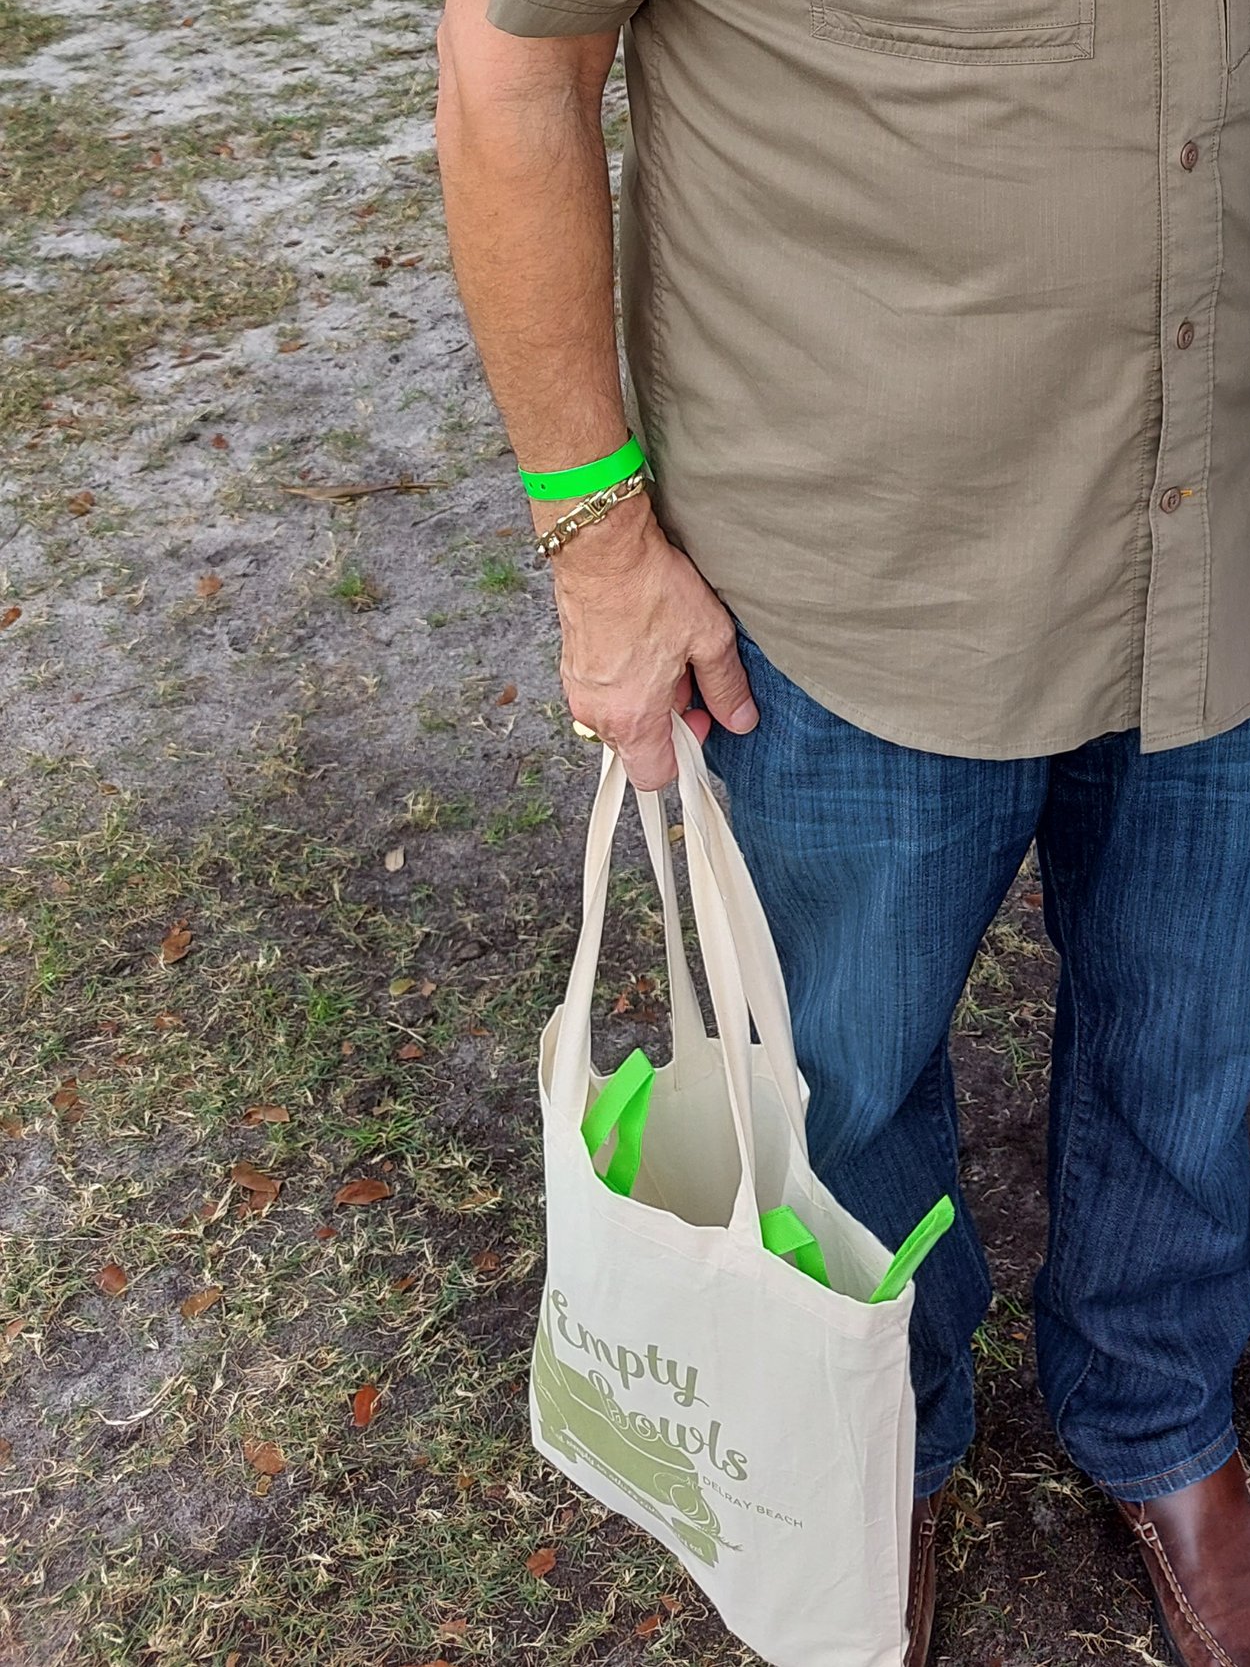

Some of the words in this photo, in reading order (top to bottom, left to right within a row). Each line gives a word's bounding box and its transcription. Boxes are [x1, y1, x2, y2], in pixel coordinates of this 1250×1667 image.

[550, 1289, 709, 1407] Empty
[587, 1369, 748, 1481] Bowls
[702, 1475, 752, 1510] DELRAY
[756, 1505, 803, 1528] BEACH
